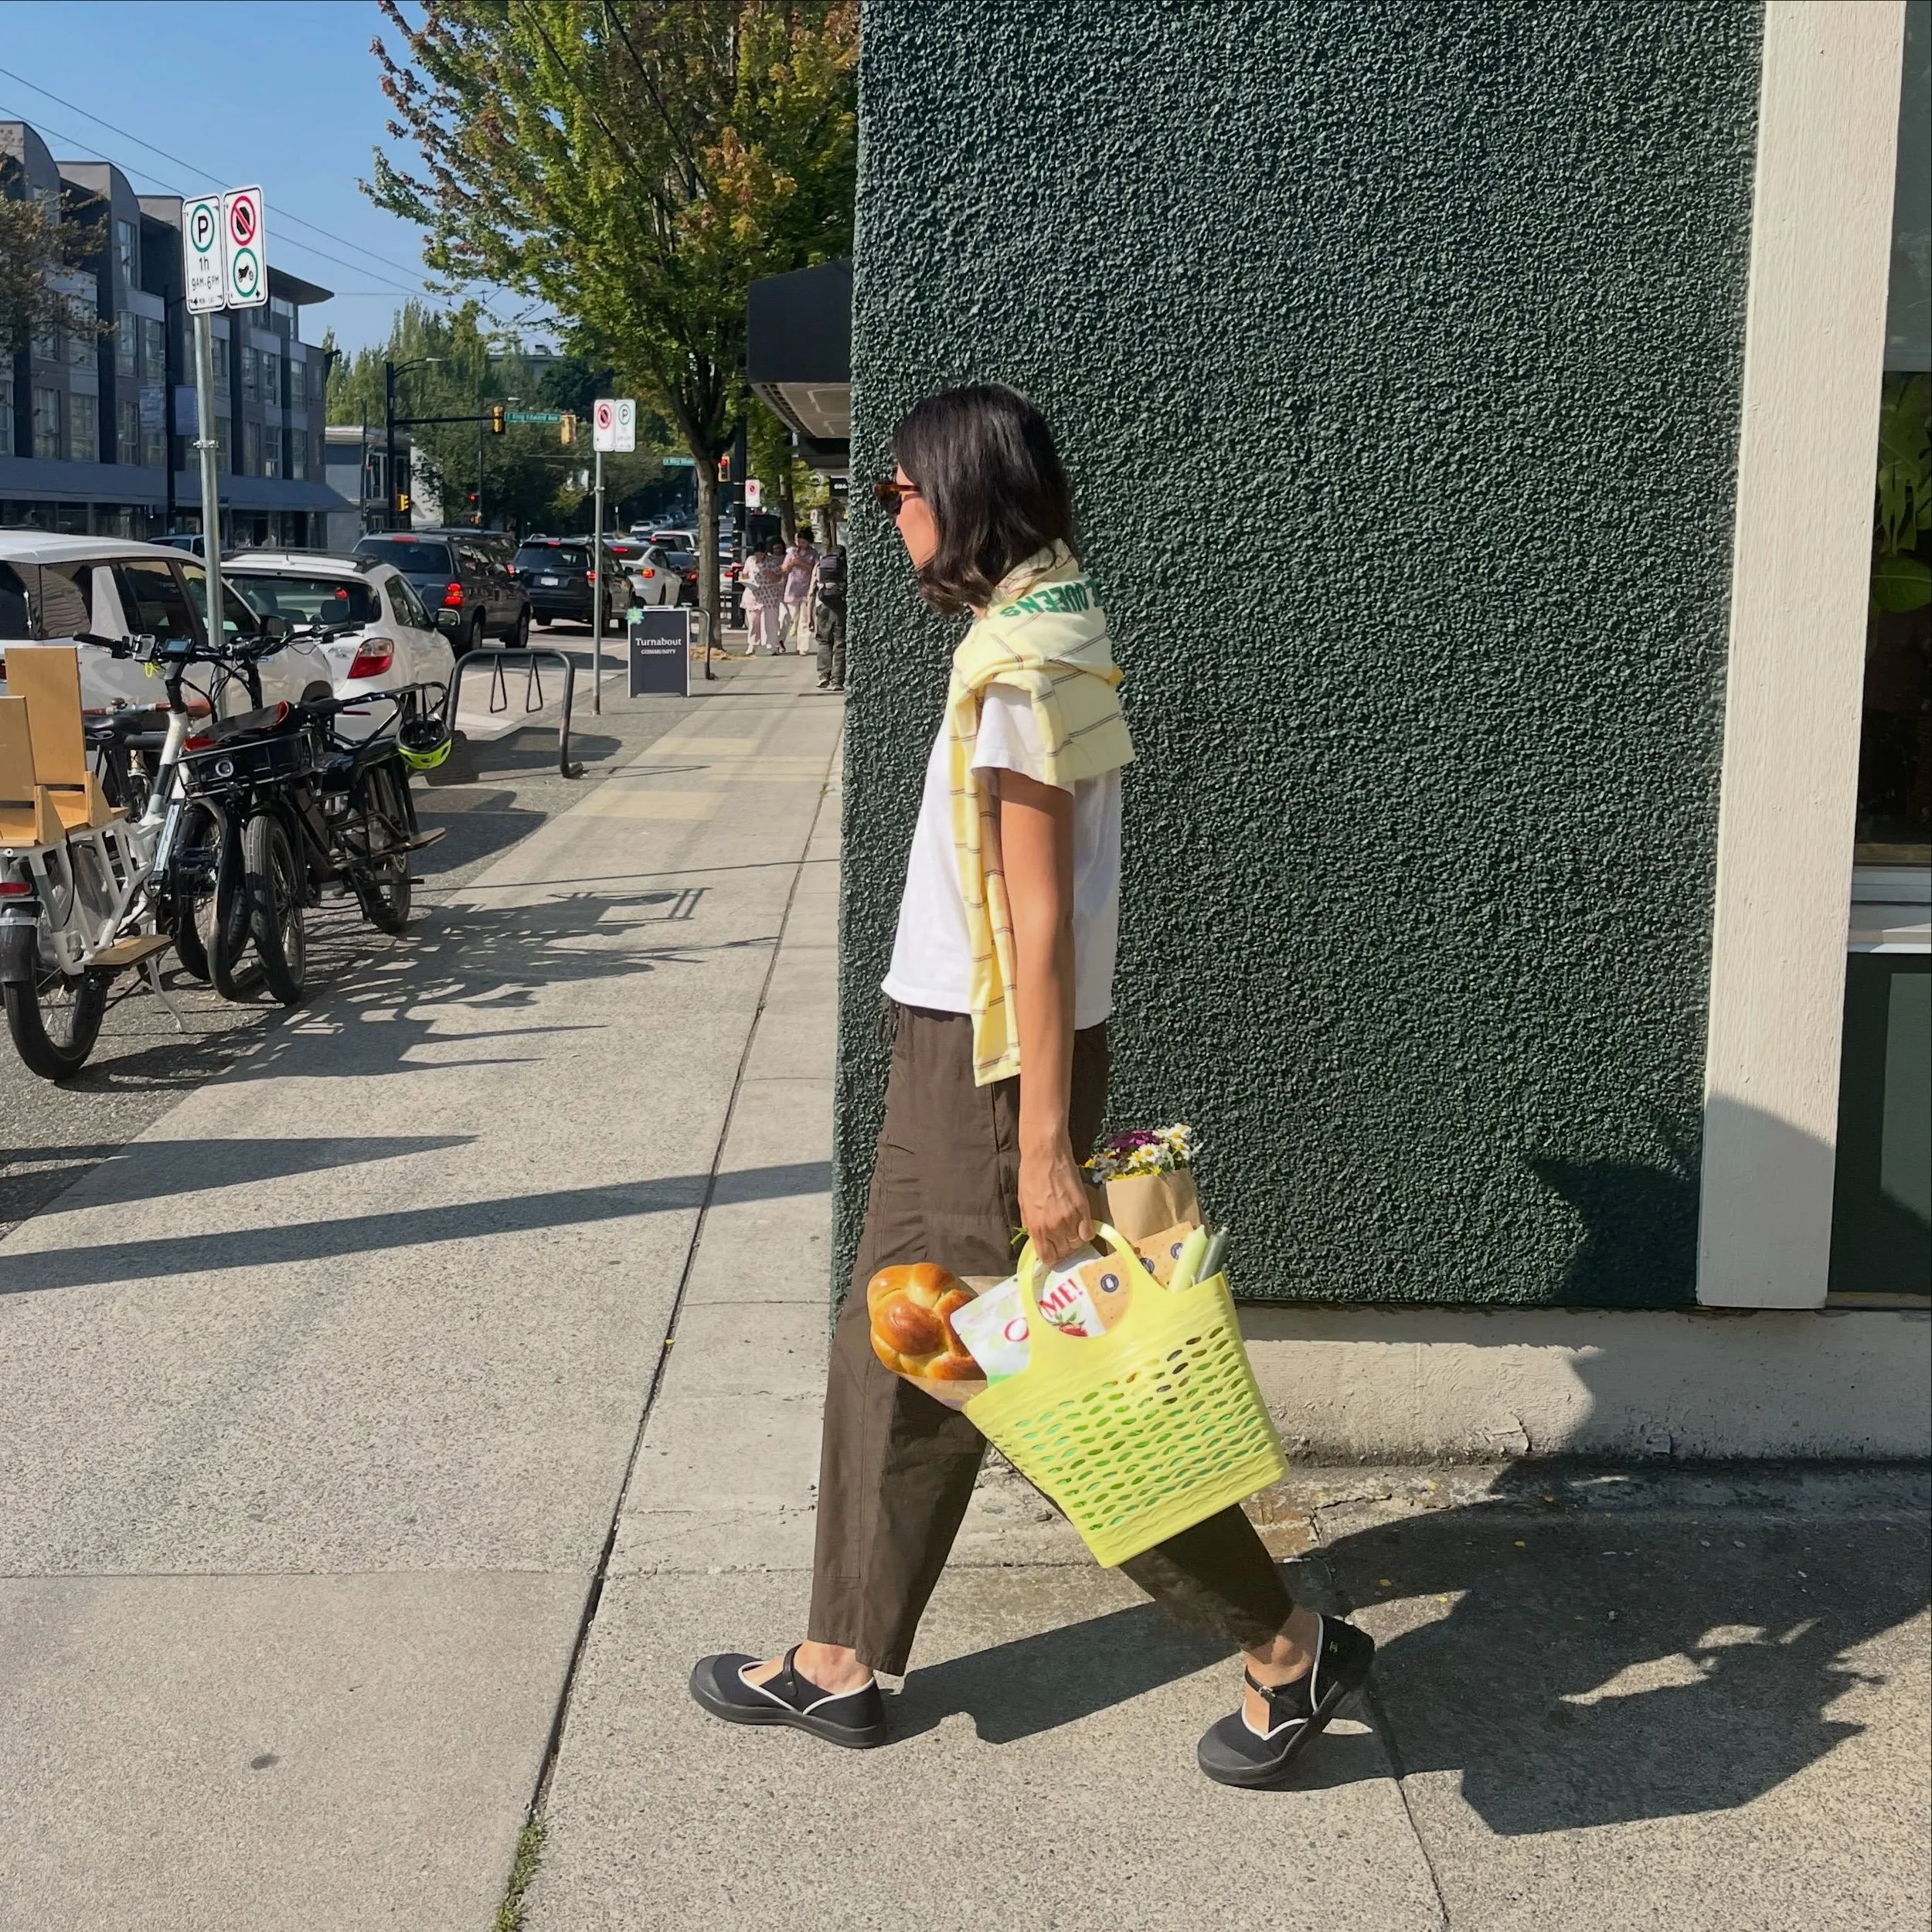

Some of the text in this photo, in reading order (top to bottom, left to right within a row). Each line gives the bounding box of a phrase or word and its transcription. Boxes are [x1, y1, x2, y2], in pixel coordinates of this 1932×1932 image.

[198, 216, 209, 243] P
[199, 257, 209, 271] 1h
[622, 409, 628, 420] P
[635, 638, 682, 646] Turnabout
